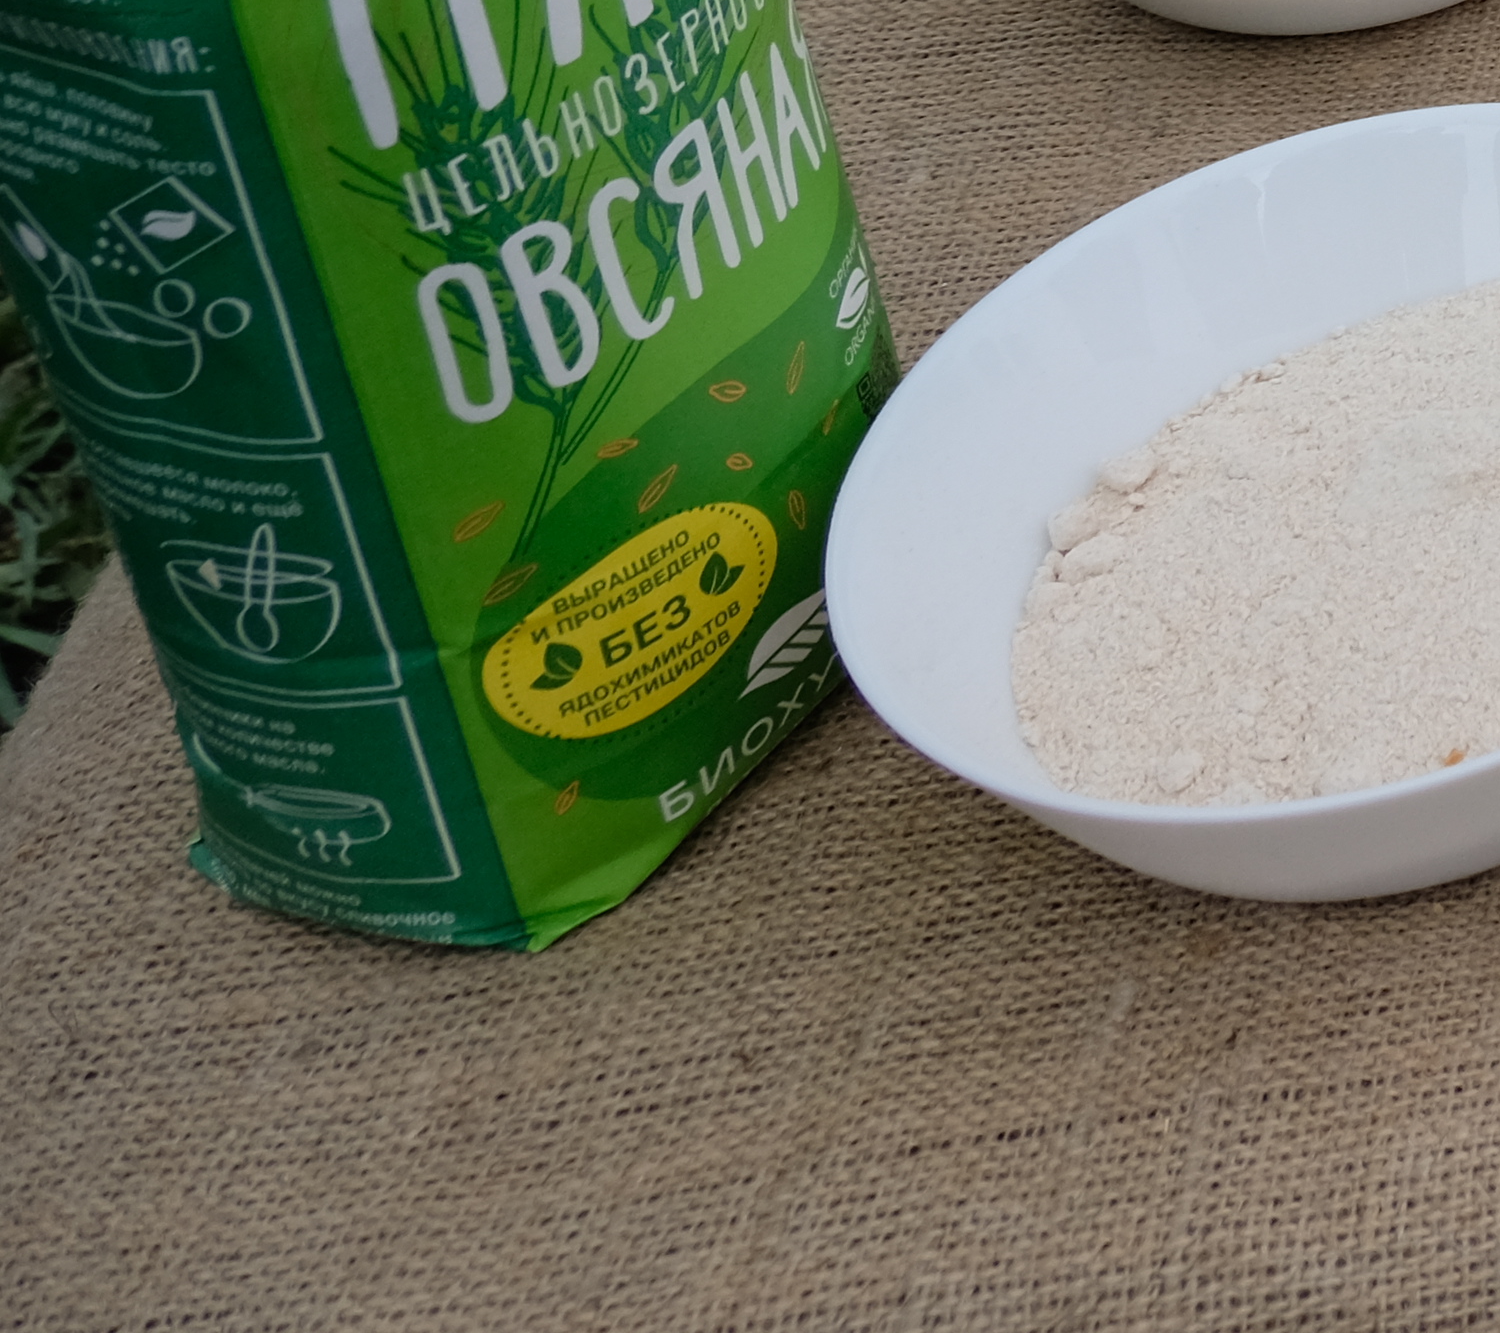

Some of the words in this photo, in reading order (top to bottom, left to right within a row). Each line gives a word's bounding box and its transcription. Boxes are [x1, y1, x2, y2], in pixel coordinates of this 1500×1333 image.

[529, 626, 552, 645] И
[555, 532, 722, 636] ПРОИЗВЕДЕНО
[552, 529, 692, 616] ВЫРАЩЕНО
[558, 599, 742, 717] ЯДОХИМИКАТОВ
[583, 629, 732, 727] ПЕСТИЦИДОВ
[599, 594, 692, 669] БЕЗ
